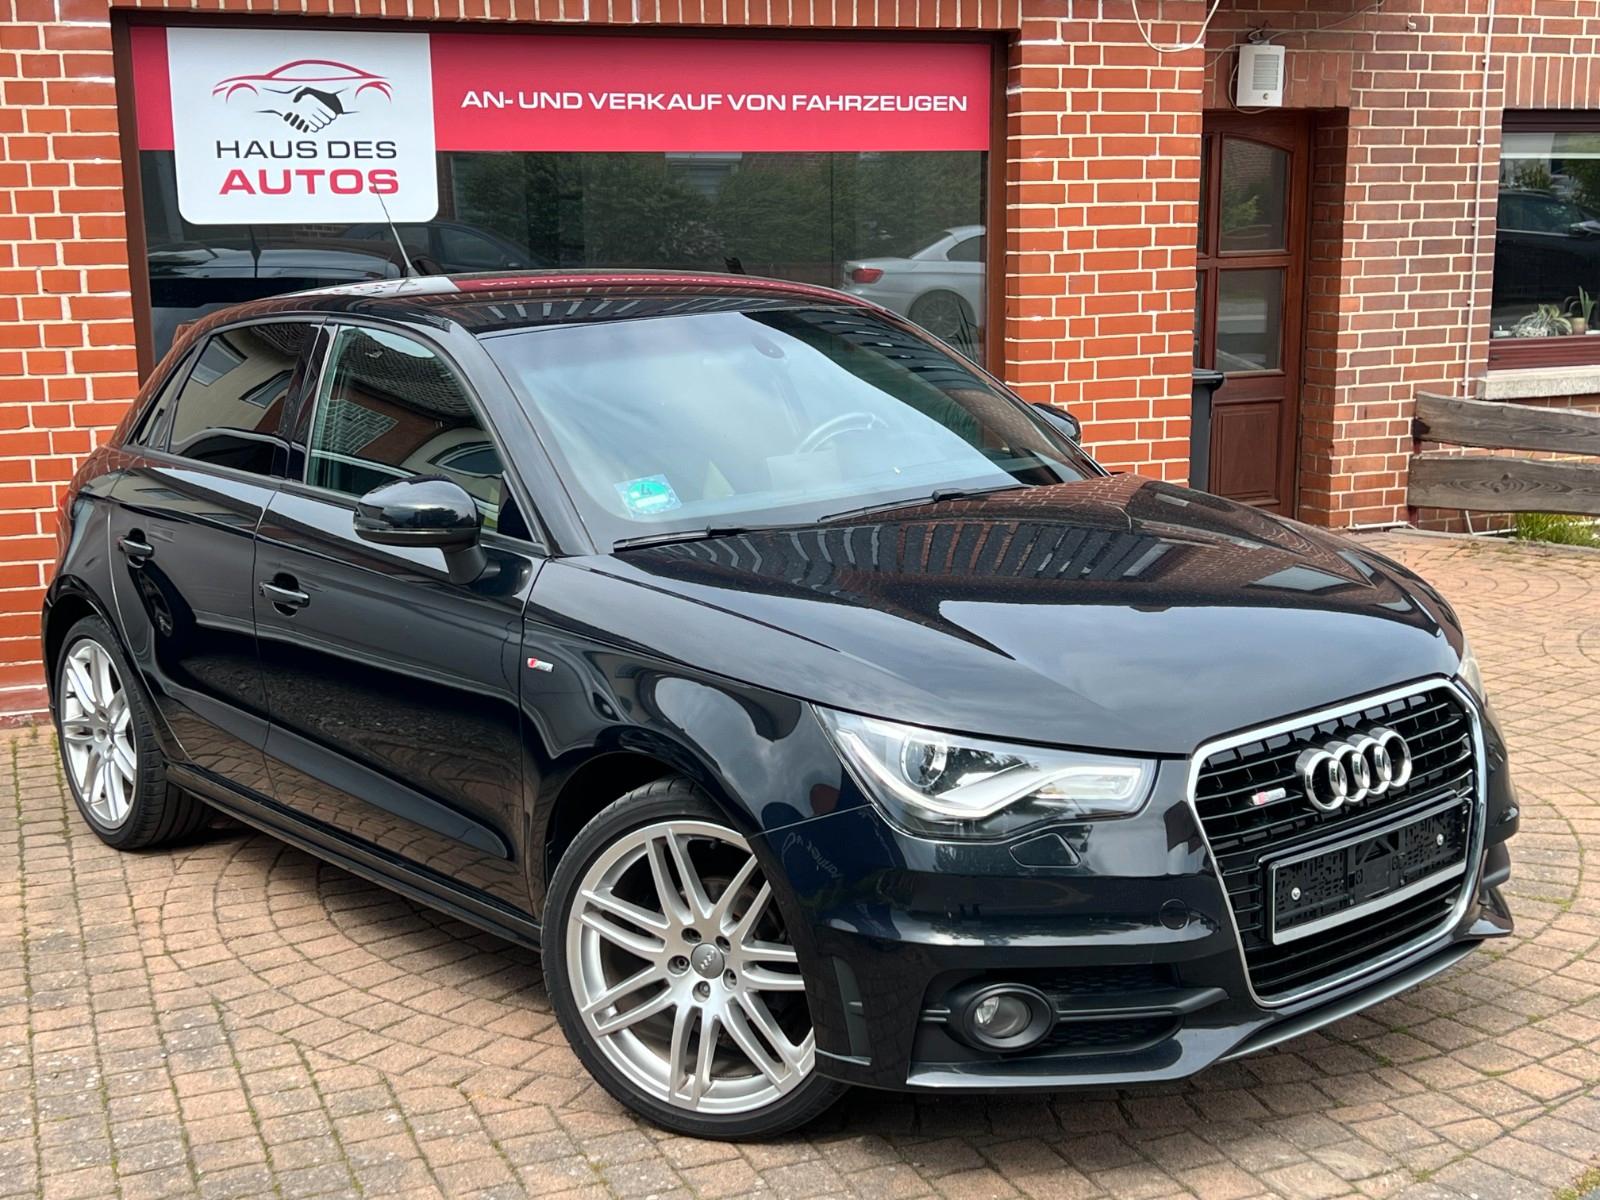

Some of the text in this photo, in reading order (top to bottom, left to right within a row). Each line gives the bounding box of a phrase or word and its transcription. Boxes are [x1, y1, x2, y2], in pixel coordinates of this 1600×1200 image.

[461, 90, 967, 112] AN- UND VERKAUF VON FAHRZEUGEN
[216, 140, 397, 159] HAUS DES
[219, 168, 399, 195] AUTOS
